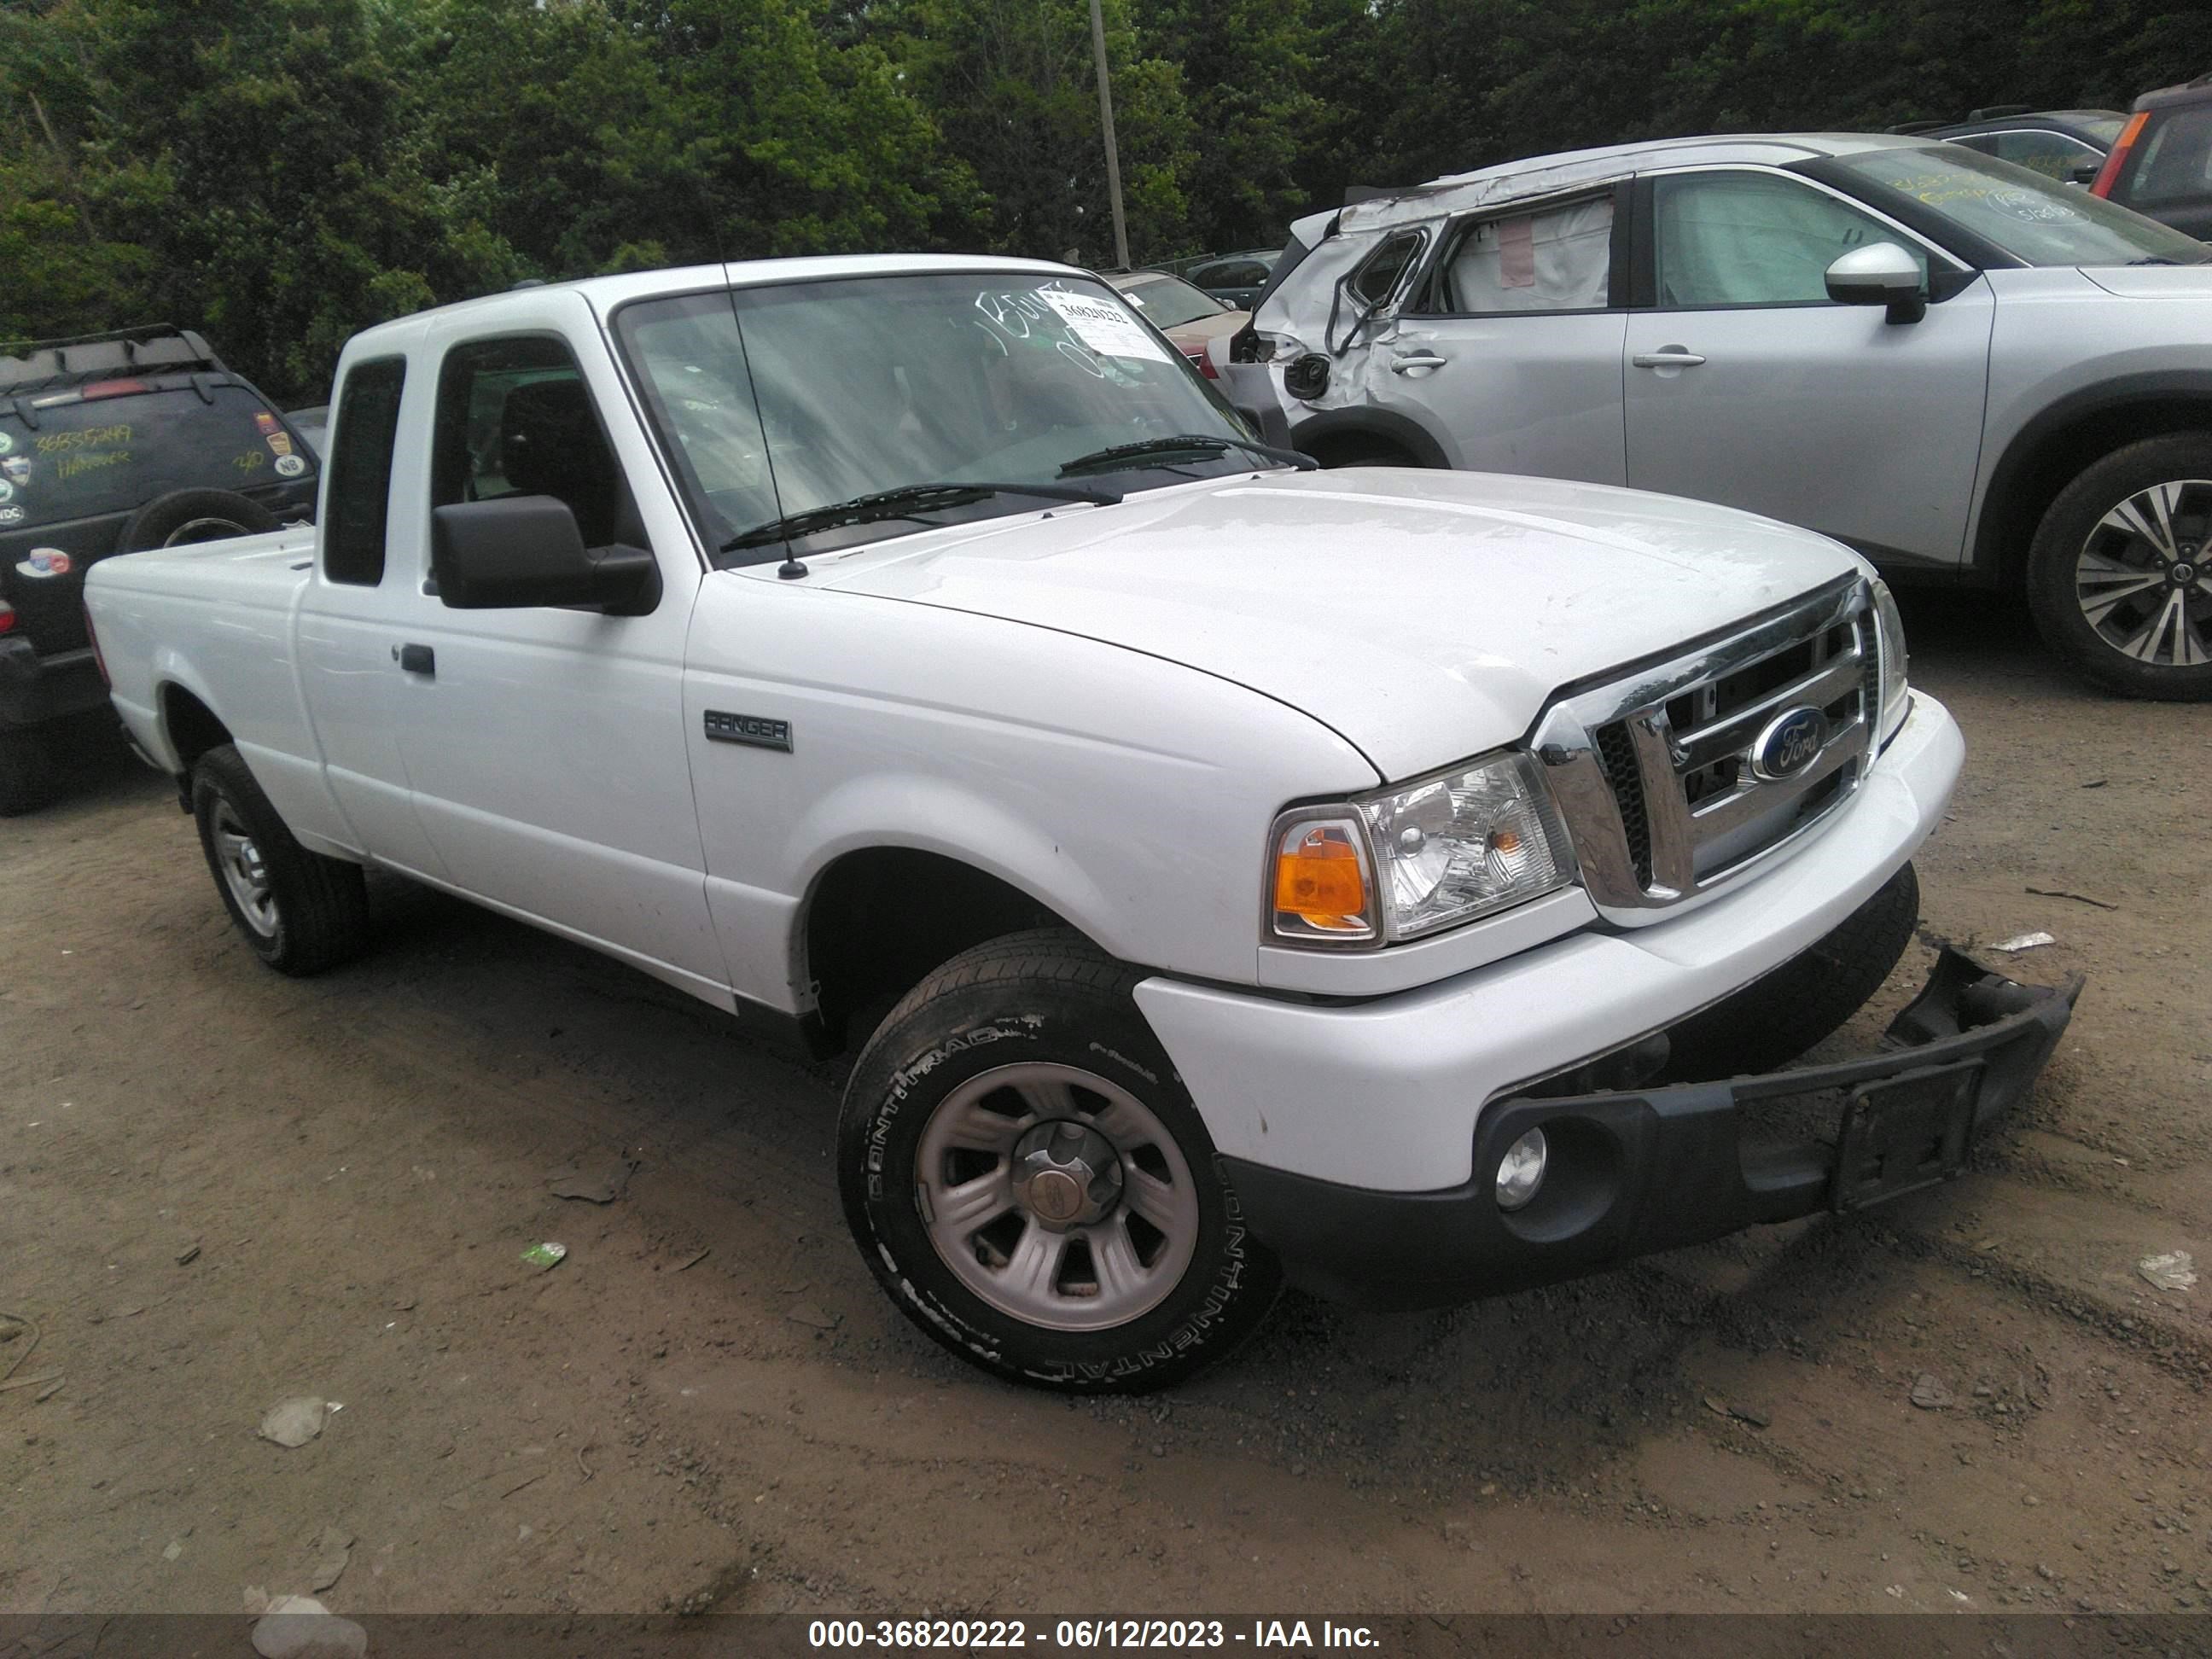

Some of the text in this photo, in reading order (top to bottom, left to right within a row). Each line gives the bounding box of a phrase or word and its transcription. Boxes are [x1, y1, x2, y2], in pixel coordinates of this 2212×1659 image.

[1059, 303, 1128, 325] 36820222
[705, 715, 788, 740] RANGER
[1780, 720, 1819, 767] Ford
